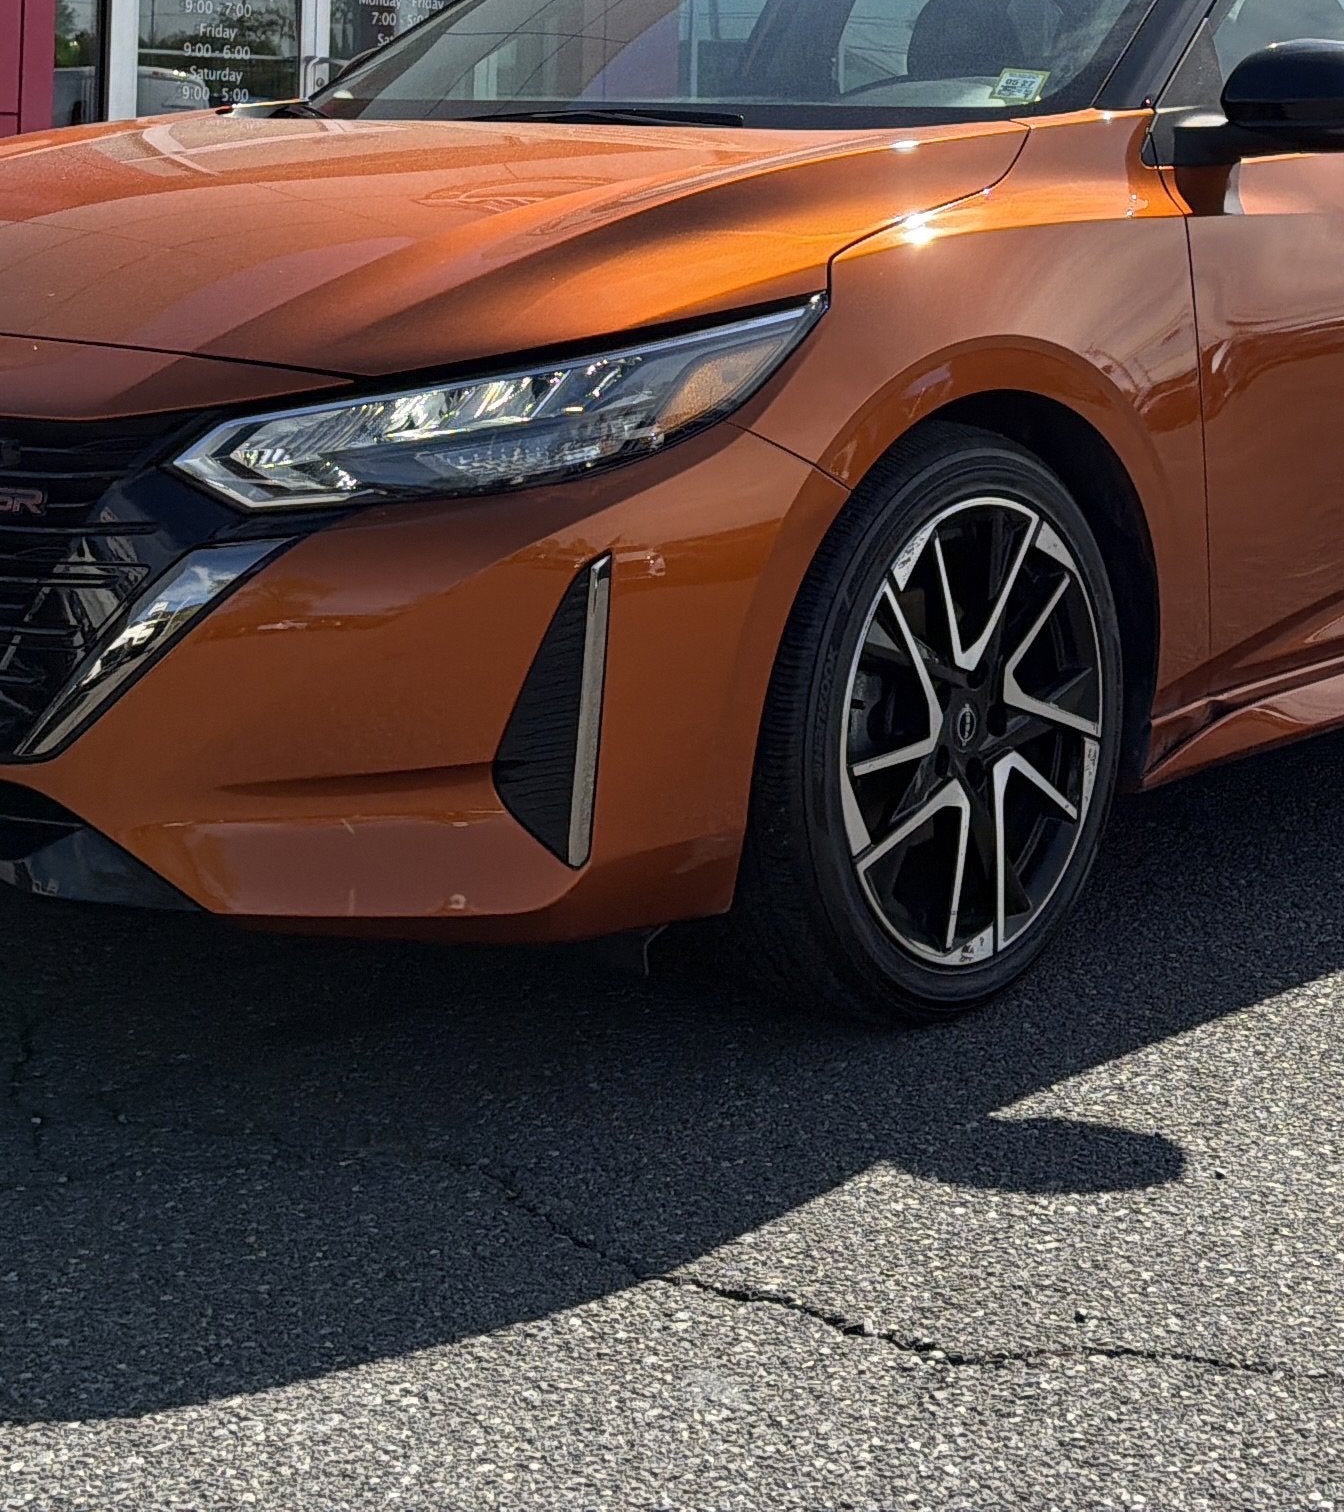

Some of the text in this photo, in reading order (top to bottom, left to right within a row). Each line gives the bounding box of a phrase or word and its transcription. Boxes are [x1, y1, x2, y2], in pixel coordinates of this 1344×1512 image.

[185, 0, 214, 15] 9:00
[225, 2, 252, 18] 7:00
[371, 12, 397, 26] 7:00
[407, 14, 429, 27] 5:0
[199, 23, 238, 42] Friday
[183, 42, 212, 58] 9:00
[223, 45, 251, 60] 6:00
[189, 65, 244, 85] Saturday
[182, 85, 210, 101] 9:00
[221, 88, 249, 103] 5:00
